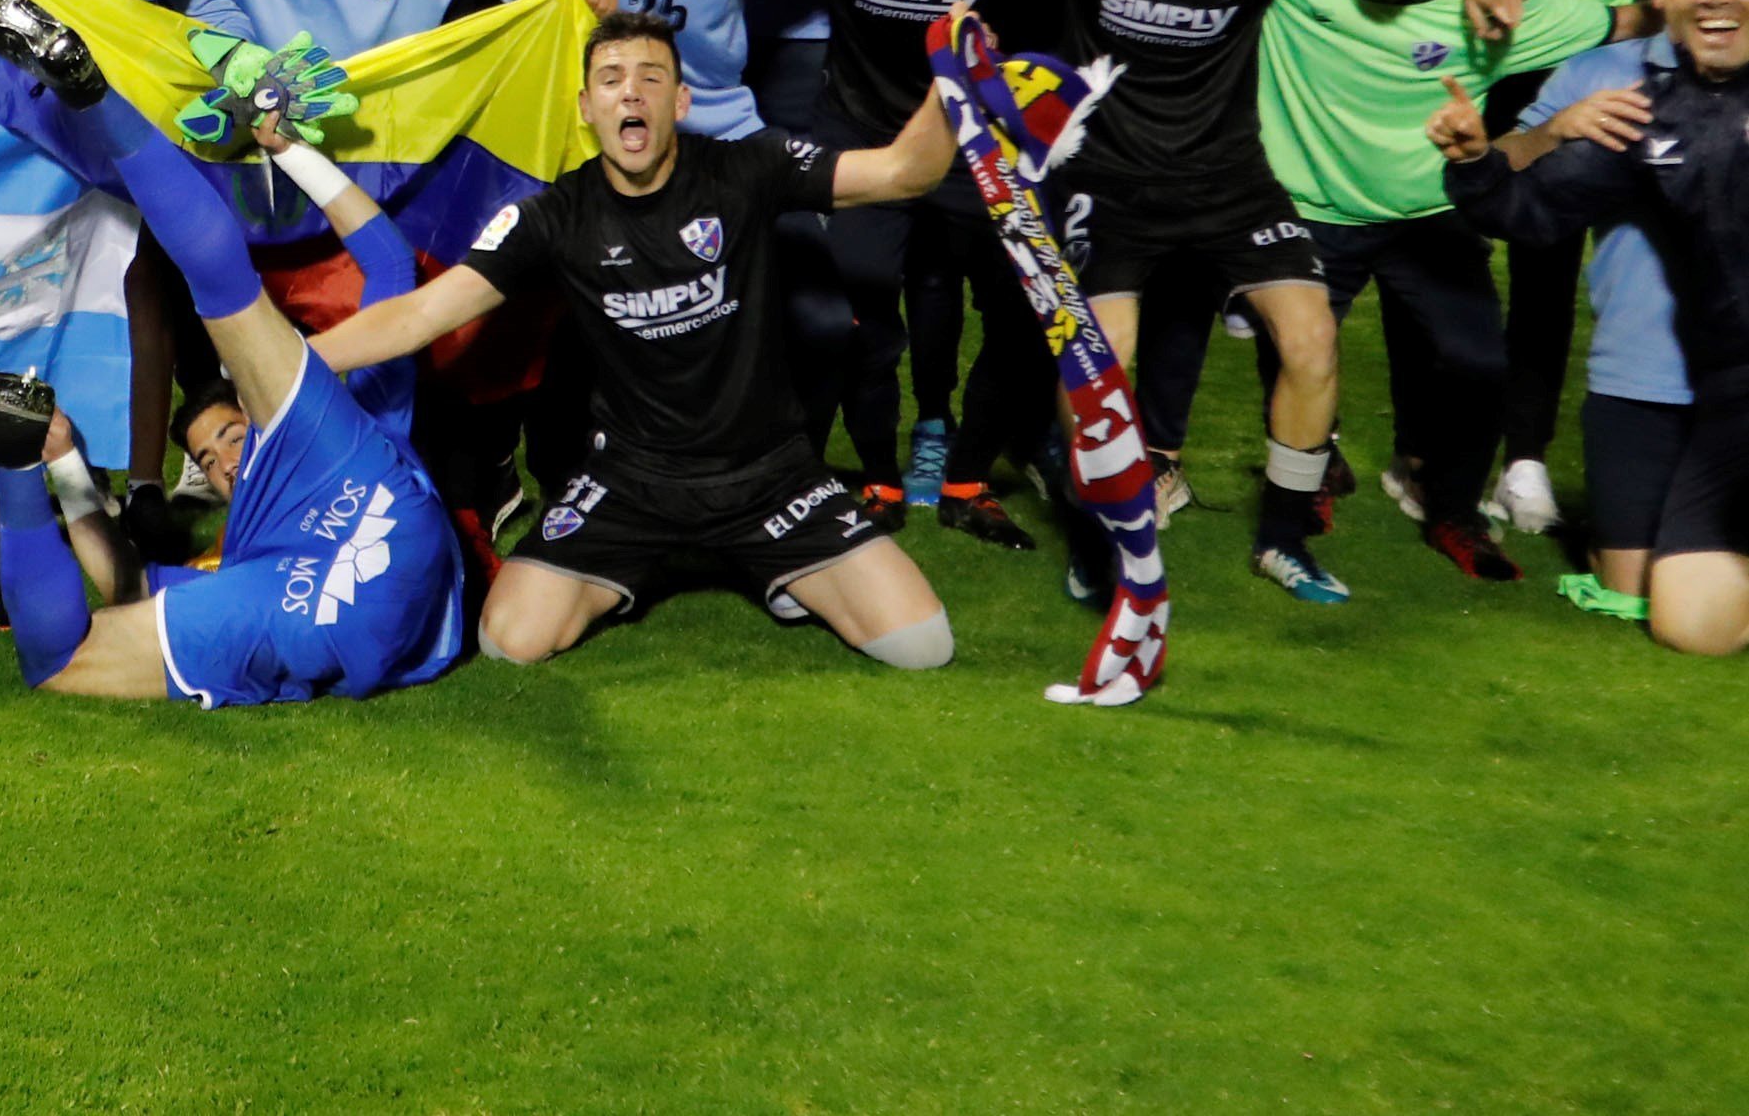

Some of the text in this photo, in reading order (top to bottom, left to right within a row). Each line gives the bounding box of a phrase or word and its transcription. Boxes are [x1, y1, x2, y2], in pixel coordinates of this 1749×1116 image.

[1064, 193, 1093, 239] 2
[299, 507, 320, 533] BOD
[314, 478, 367, 542] SOM
[281, 556, 322, 616] MOS
